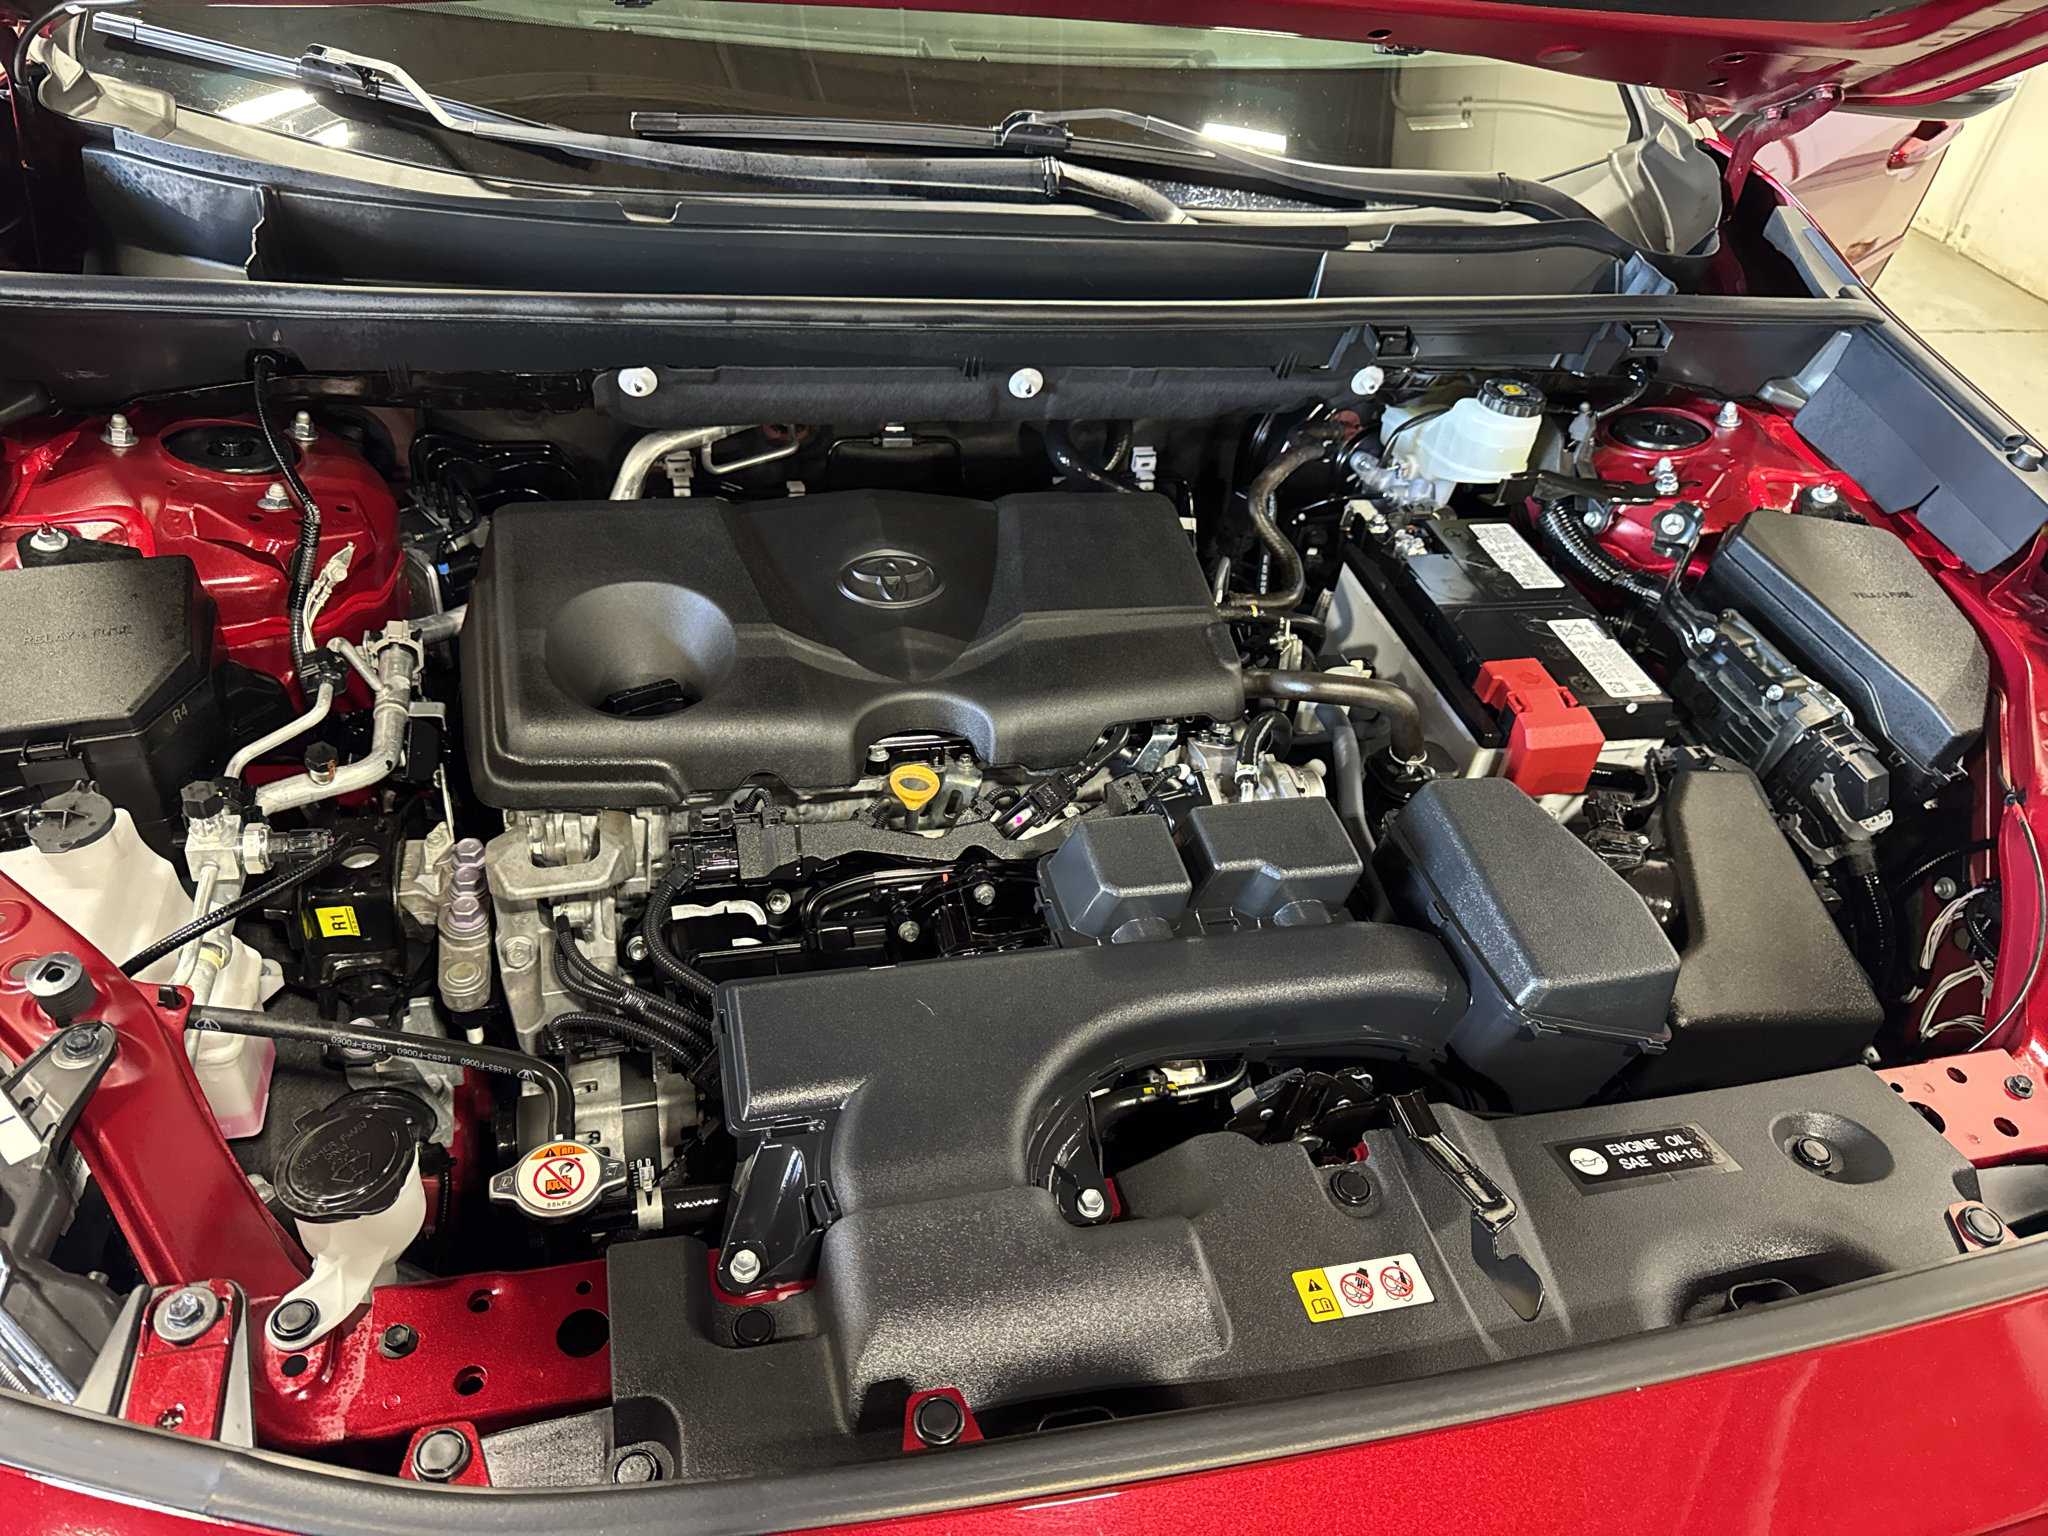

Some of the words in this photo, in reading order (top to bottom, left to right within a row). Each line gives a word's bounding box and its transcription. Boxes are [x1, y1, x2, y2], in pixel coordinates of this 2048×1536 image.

[171, 703, 189, 725] R4
[330, 914, 348, 931] R1
[324, 1143, 350, 1161] ONLY
[1605, 1138, 1661, 1156] ENGINE
[1664, 1134, 1692, 1147] OIL
[295, 1141, 338, 1172] WASHER
[1618, 1155, 1652, 1170] SAE
[1656, 1147, 1704, 1165] 0W-16
[546, 1199, 572, 1209] 88kPa
